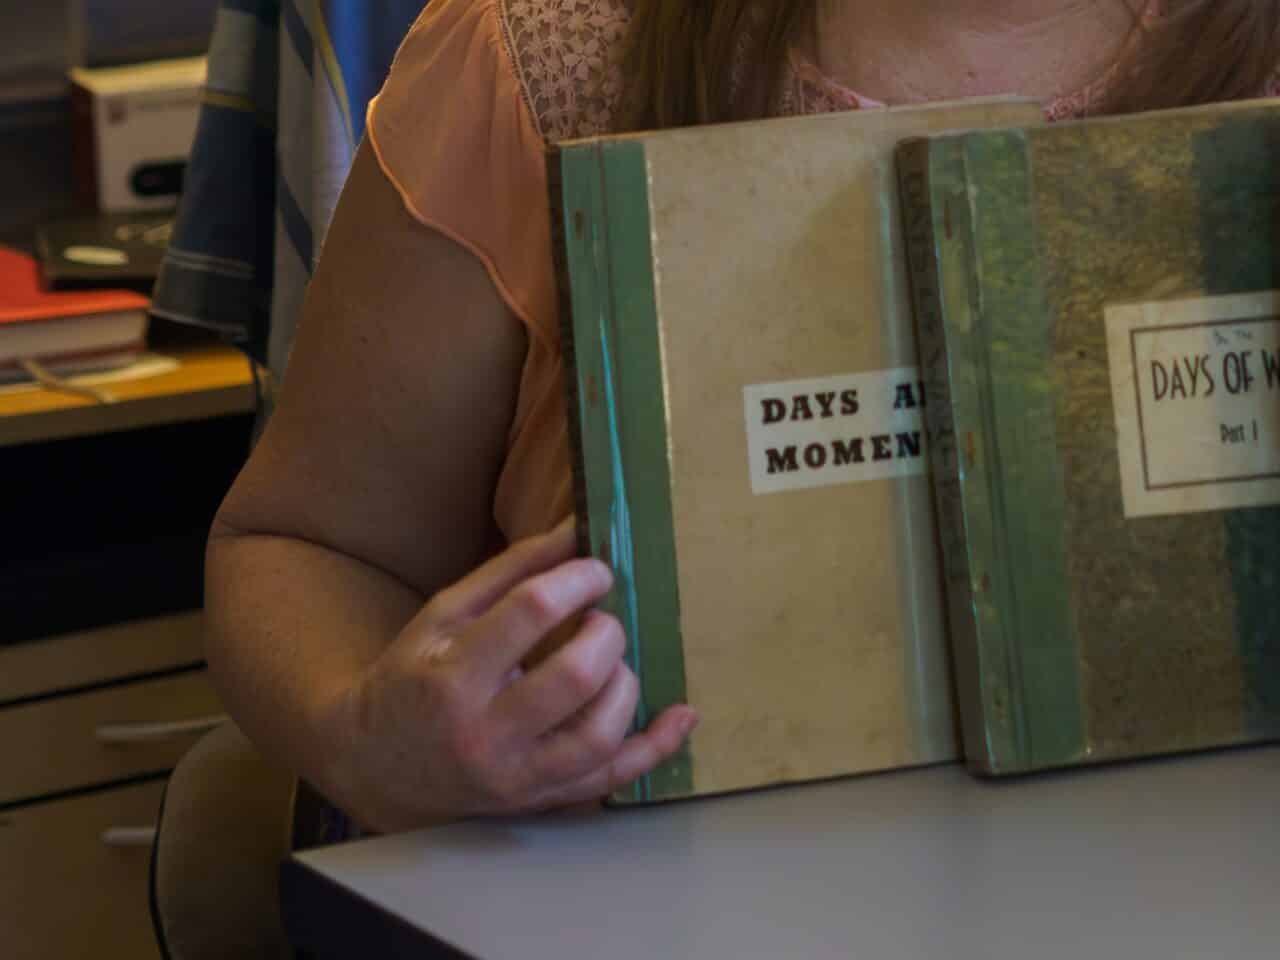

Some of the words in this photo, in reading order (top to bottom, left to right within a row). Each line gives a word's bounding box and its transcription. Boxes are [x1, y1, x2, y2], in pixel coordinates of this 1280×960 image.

[1151, 353, 1215, 402] DAYS
[1222, 350, 1255, 395] OF
[760, 389, 860, 425] DAYS
[1220, 423, 1246, 444] Part
